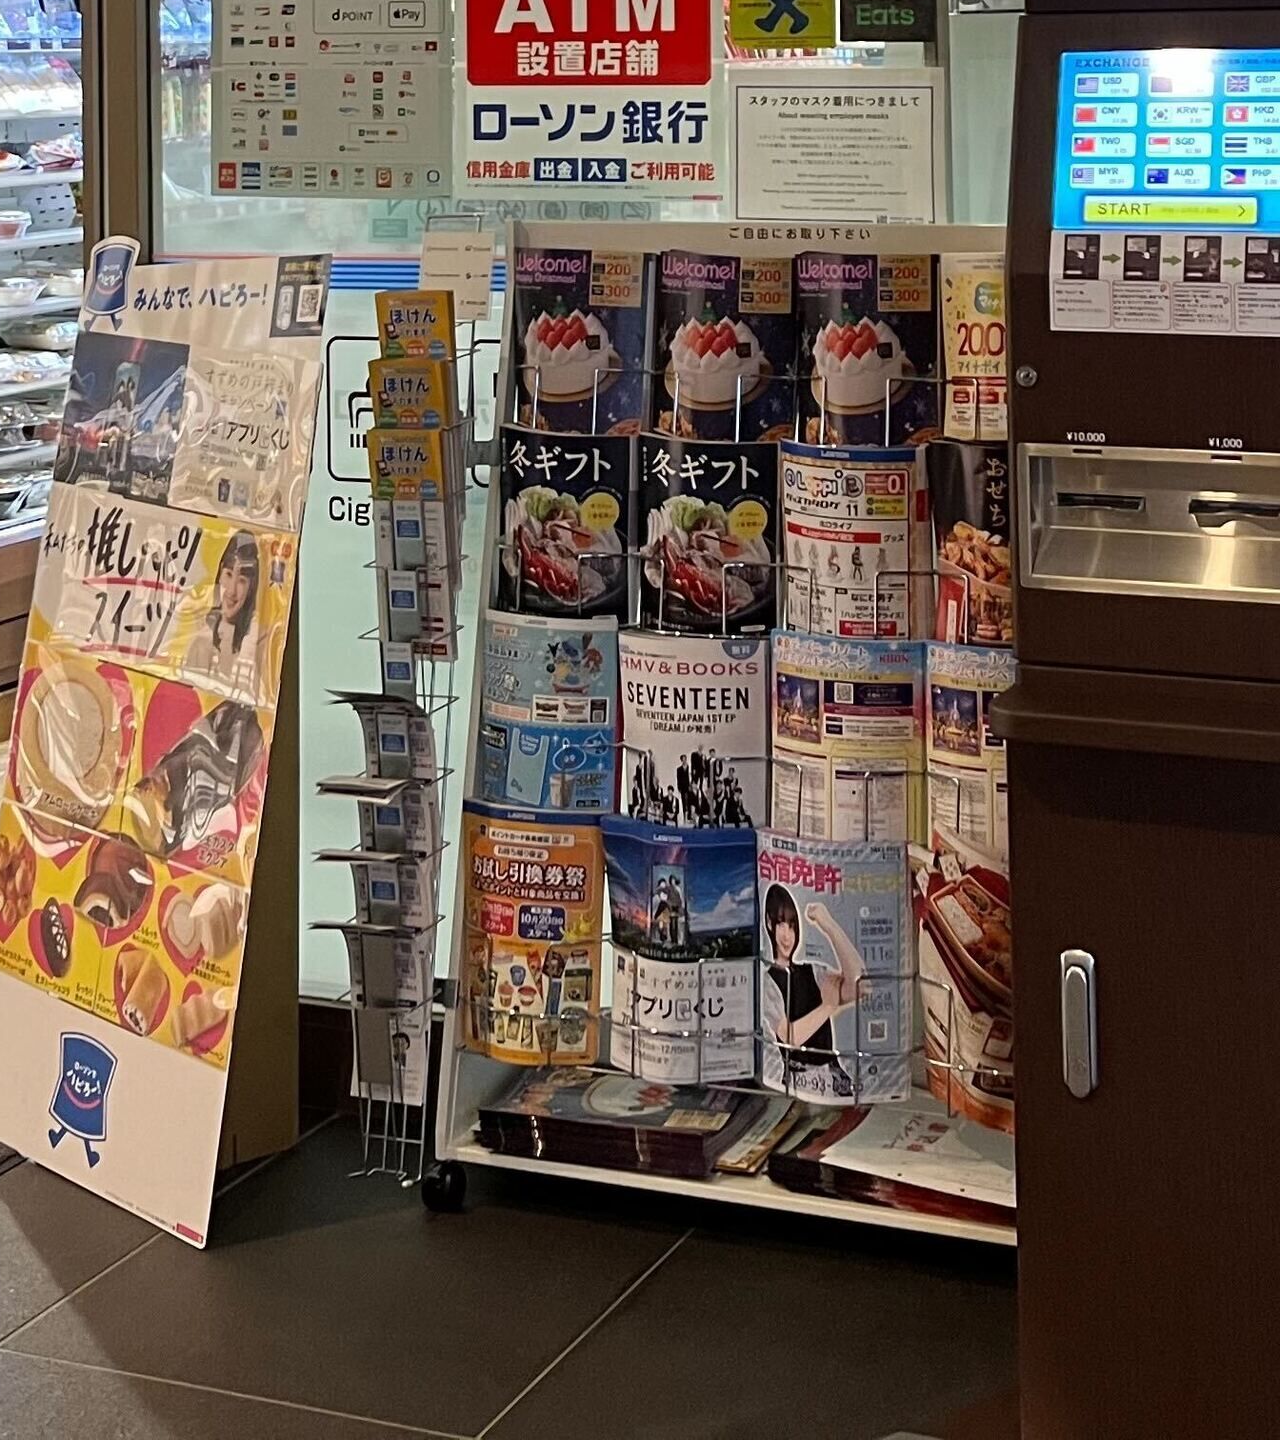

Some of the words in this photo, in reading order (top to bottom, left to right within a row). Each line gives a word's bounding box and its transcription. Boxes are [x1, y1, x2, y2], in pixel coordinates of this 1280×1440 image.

[341, 12, 373, 21] POINT
[401, 9, 421, 22] Pay
[856, 4, 915, 26] Eats
[516, 39, 660, 77] 設置店舗
[1102, 77, 1122, 85] USD
[749, 95, 920, 108] スタッフのマスク着用につきまして
[1101, 106, 1120, 114] CNY
[1176, 106, 1199, 114] KRW
[472, 101, 709, 144] ローソン銀行
[466, 160, 532, 179] 信用金庫
[539, 160, 573, 179] 出金
[587, 161, 621, 179] 入金
[630, 162, 715, 180] ご利用可能
[1098, 167, 1119, 175] MYR
[1098, 203, 1151, 215] START
[729, 226, 871, 240] ご自由にお取り下さい
[606, 263, 631, 276] 200
[662, 258, 736, 280] Welcome!
[757, 269, 781, 283] 200
[797, 258, 872, 280] Welcome!
[894, 267, 919, 279] 200
[604, 285, 630, 298] 300
[754, 292, 781, 304] 300
[894, 290, 920, 302] 300
[390, 308, 436, 324] ほけん
[384, 378, 430, 393] ほけん
[382, 446, 428, 461] ほけん
[510, 440, 612, 482] 冬ギフト
[652, 448, 760, 490] 冬ギフト
[985, 457, 1008, 528] おせち
[846, 504, 858, 516] 11
[627, 681, 749, 710] SEVENTEEN
[636, 708, 675, 722] SEVENTEEN
[677, 714, 704, 723] JAPAN
